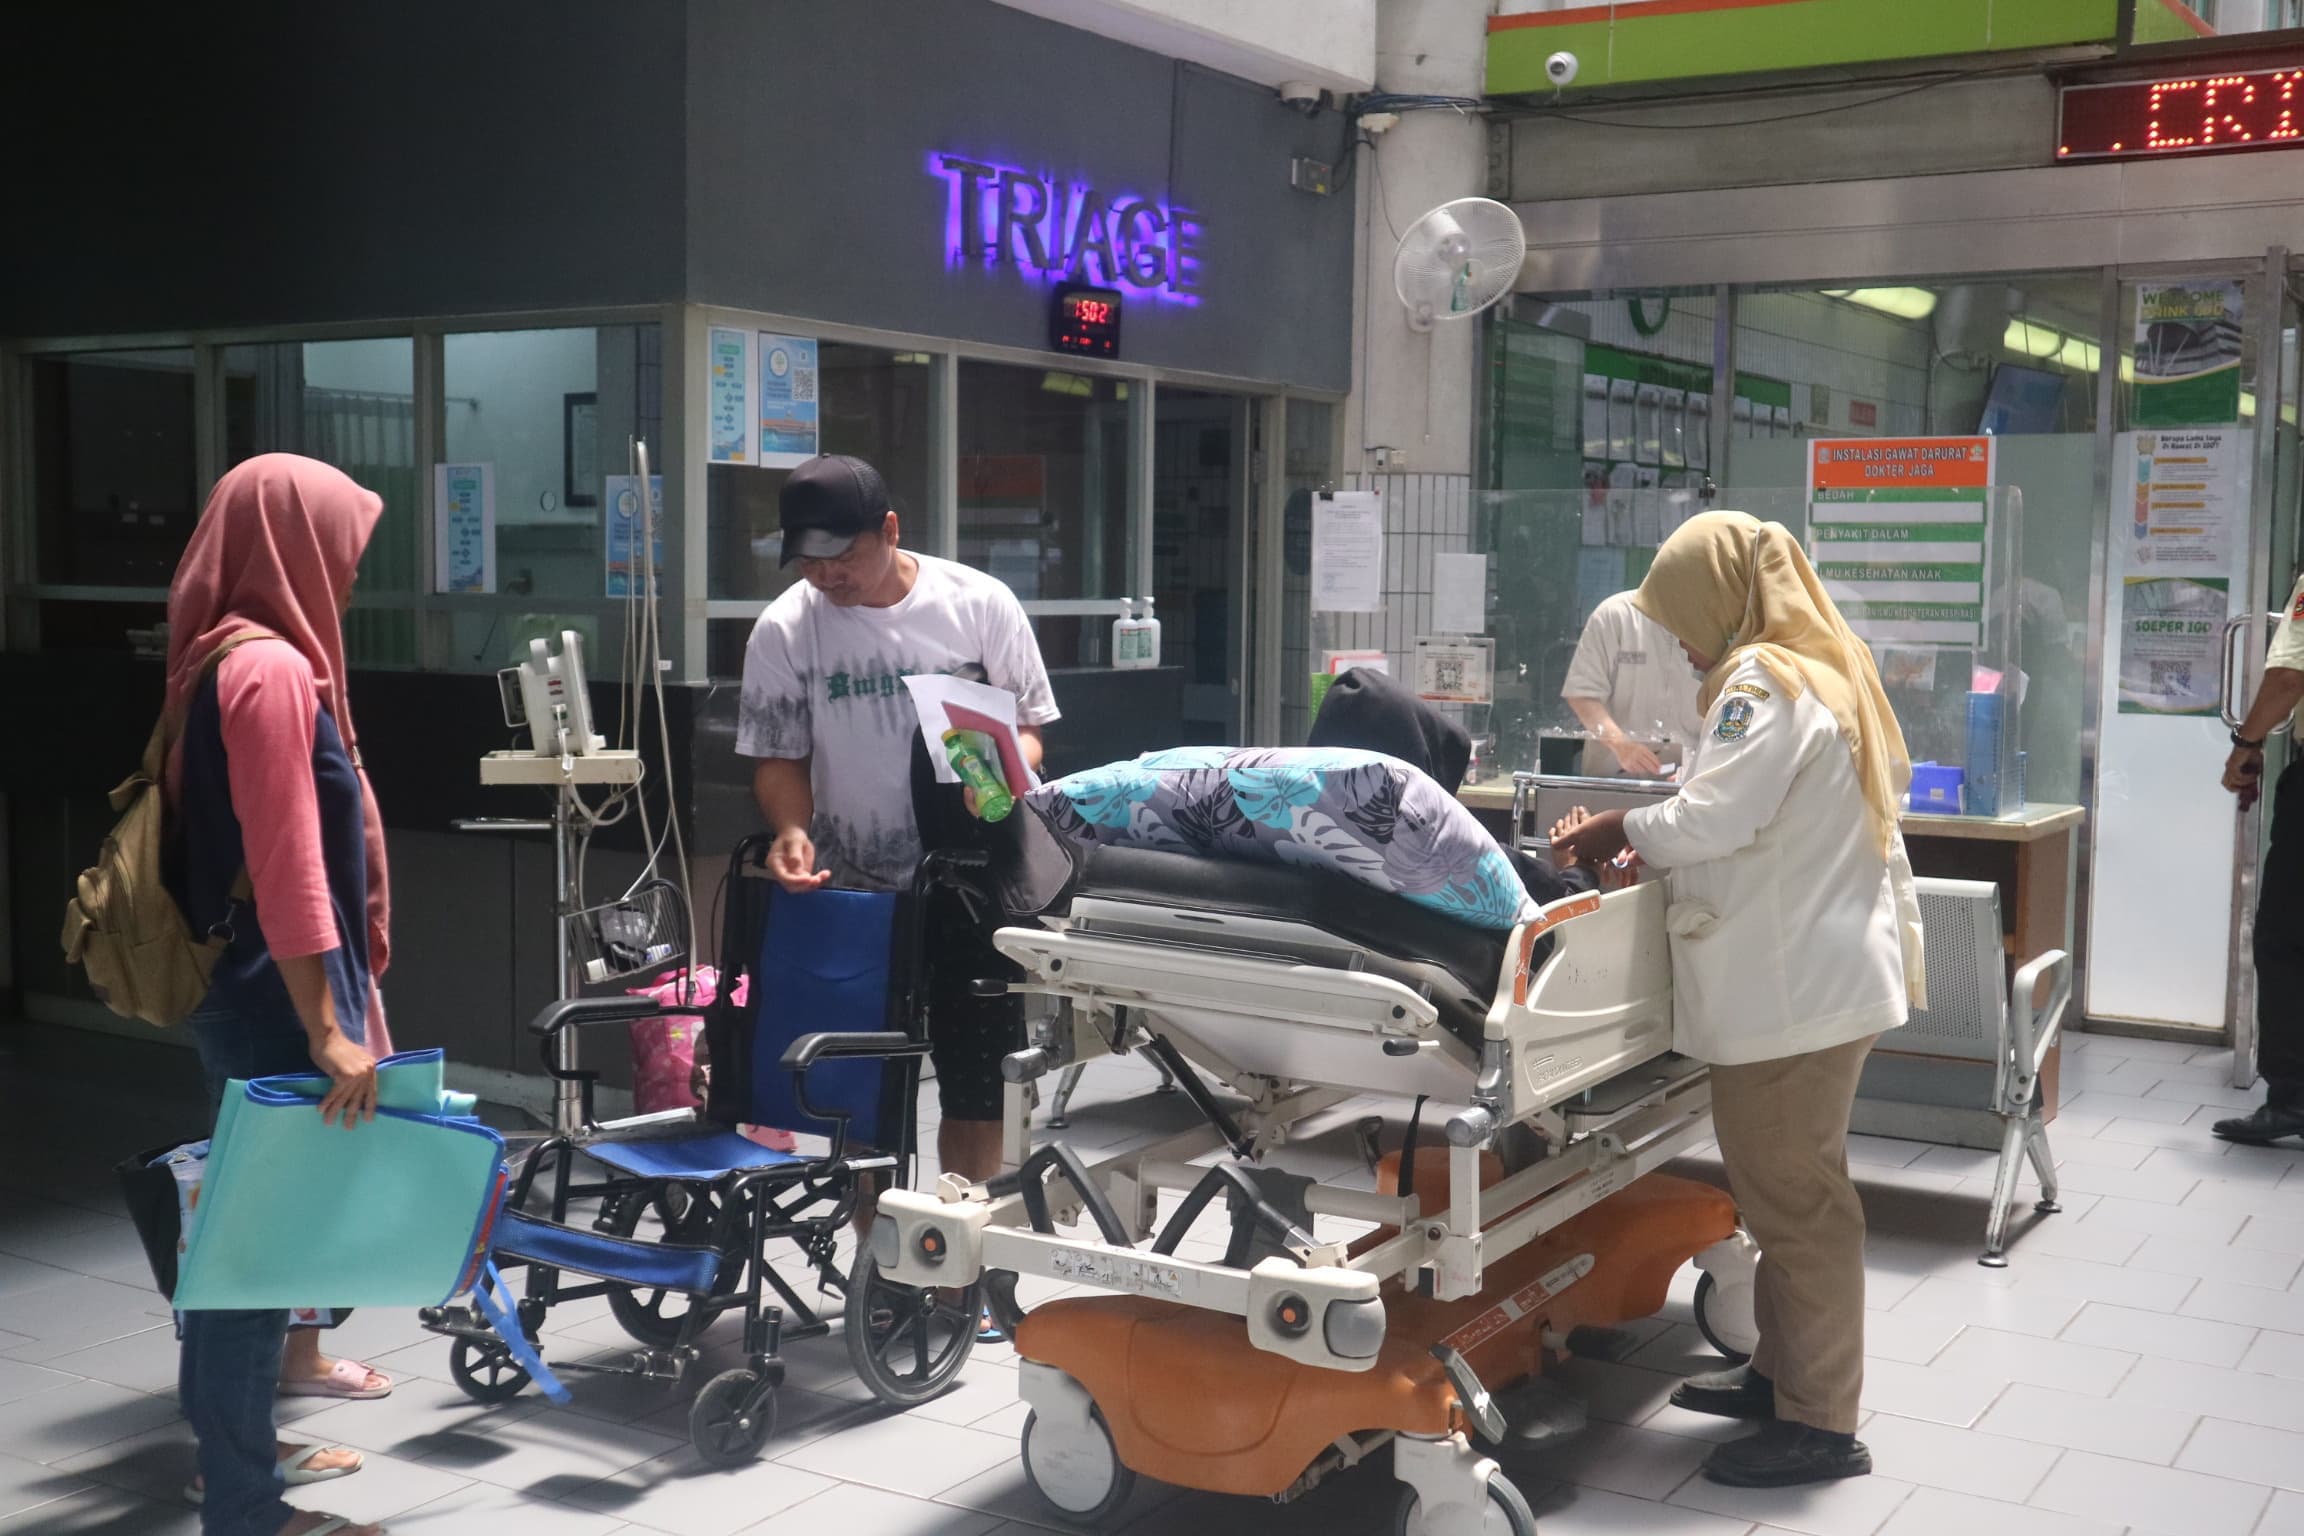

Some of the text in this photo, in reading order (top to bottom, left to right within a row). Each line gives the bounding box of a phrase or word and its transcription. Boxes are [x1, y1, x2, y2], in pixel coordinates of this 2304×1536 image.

[937, 153, 1208, 294] TRIAGE
[1832, 447, 1968, 462] INSTALASI GAWAT DARURAT
[1864, 464, 1935, 478] DOKTER JAGA
[1817, 489, 1854, 500] BEDAH
[1817, 528, 1909, 539] PENYAKIT DALAM
[1844, 567, 1909, 578] KESEHATAN
[1911, 568, 1942, 579] ANAK
[2135, 619, 2184, 633] SOEPER
